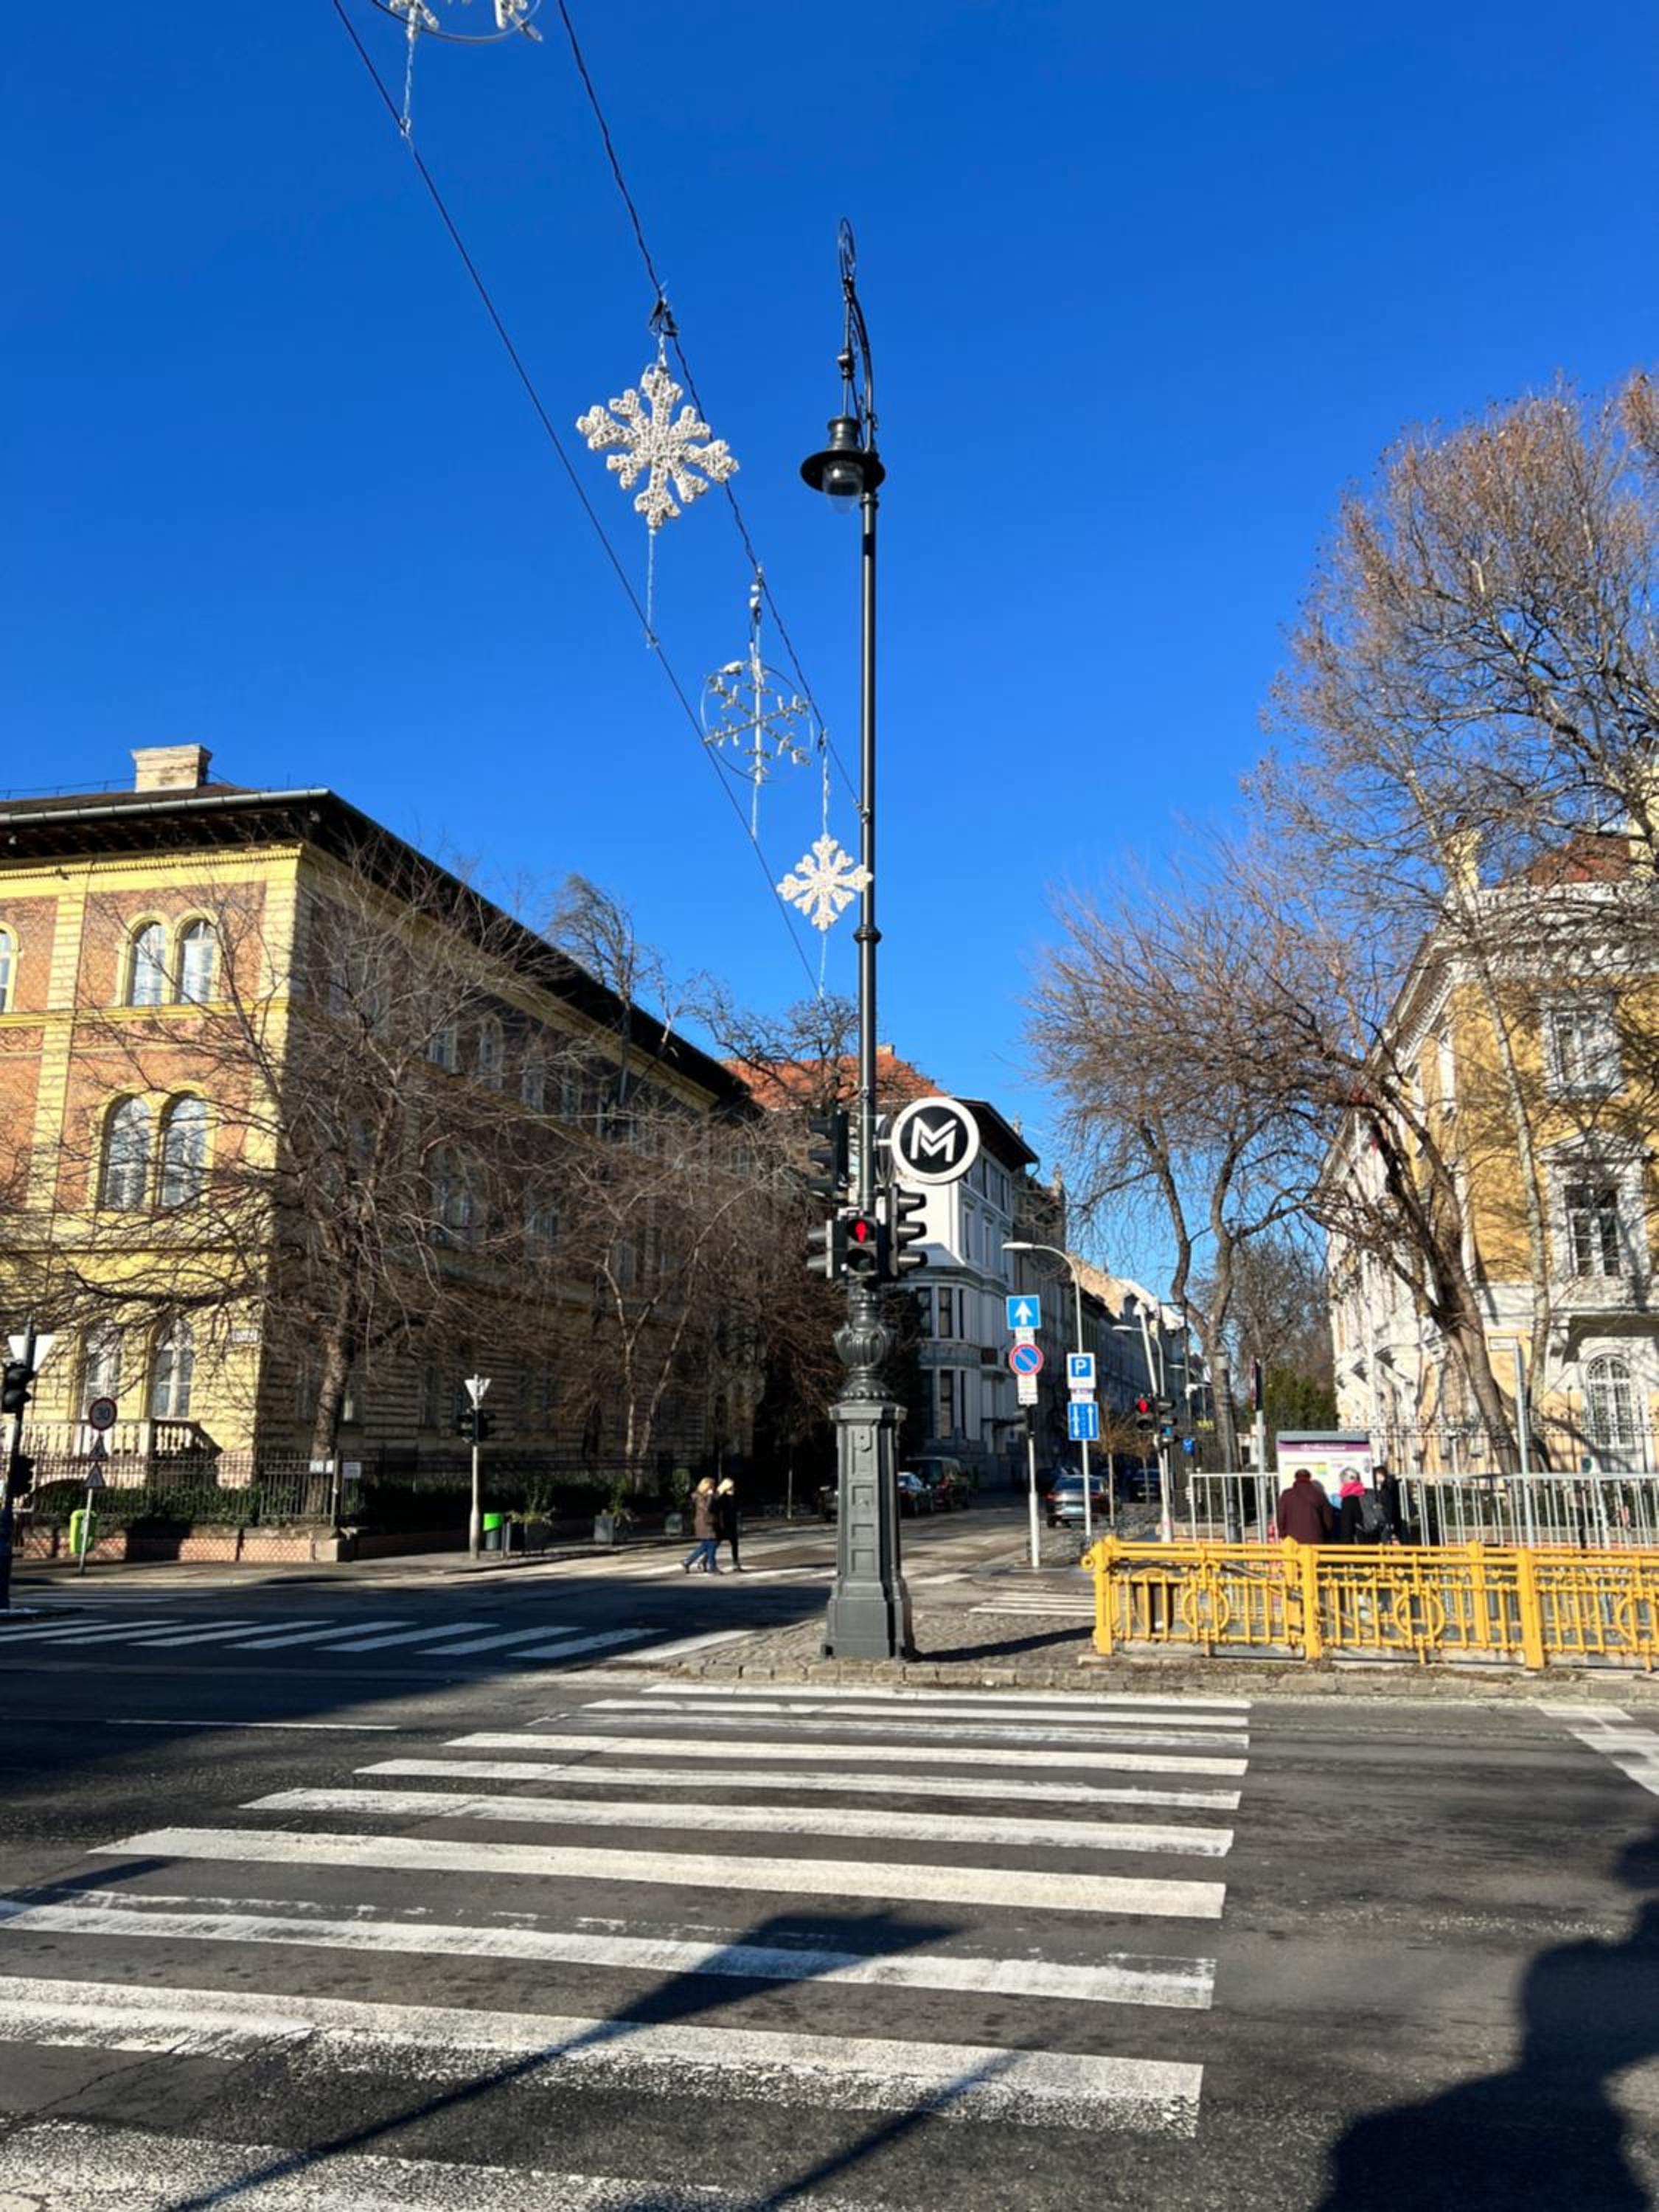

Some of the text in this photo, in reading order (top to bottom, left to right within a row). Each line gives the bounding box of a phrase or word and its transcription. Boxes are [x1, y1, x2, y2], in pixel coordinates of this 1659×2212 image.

[910, 1116, 958, 1163] M
[1075, 1359, 1088, 1376] P
[96, 1406, 111, 1421] 30
